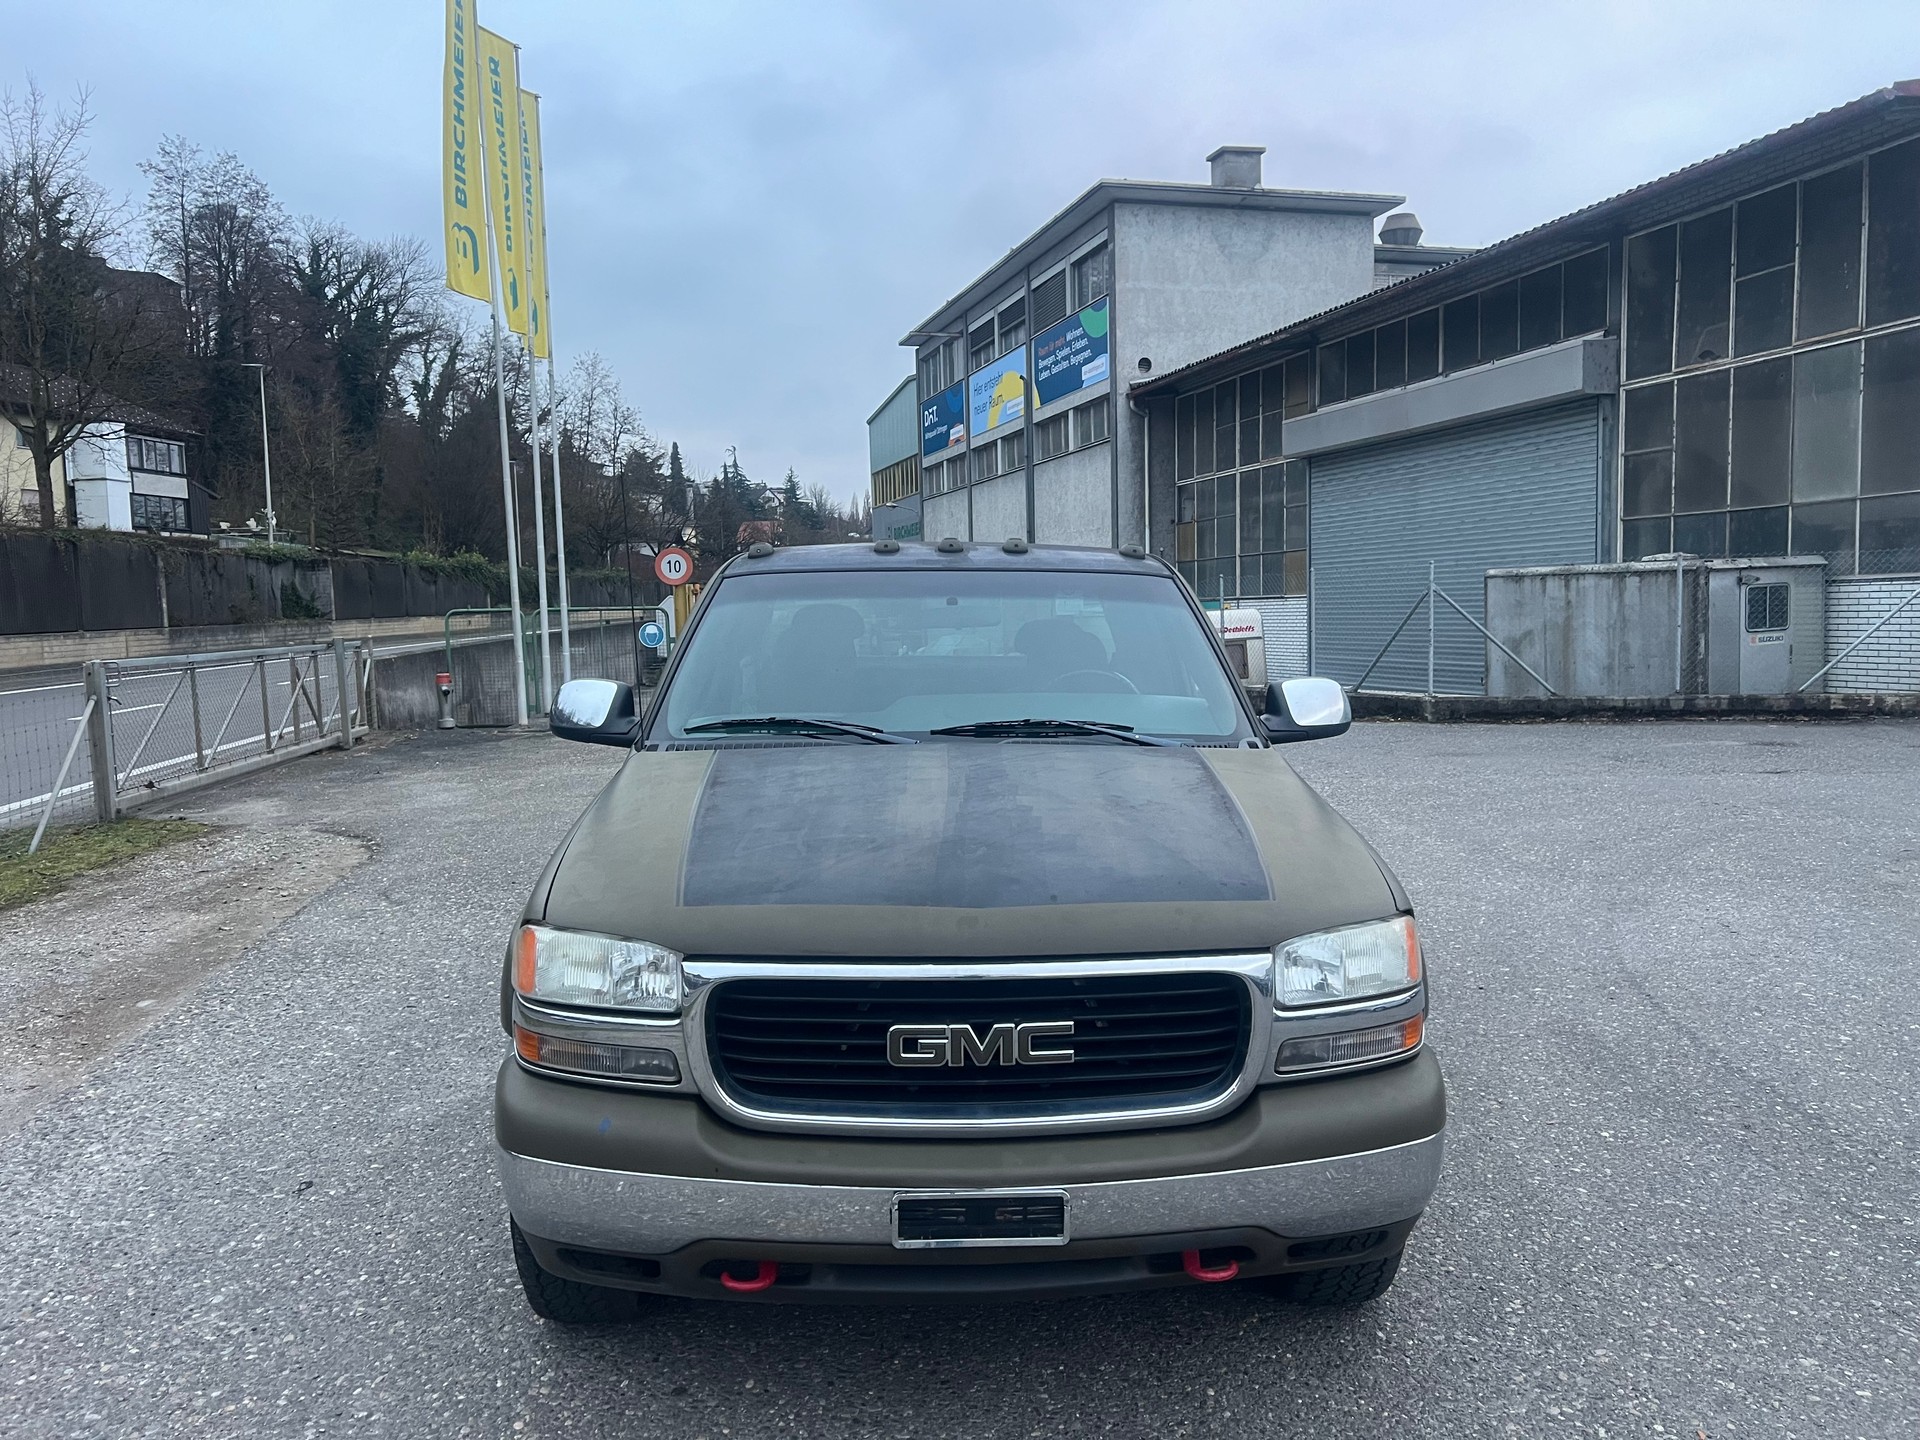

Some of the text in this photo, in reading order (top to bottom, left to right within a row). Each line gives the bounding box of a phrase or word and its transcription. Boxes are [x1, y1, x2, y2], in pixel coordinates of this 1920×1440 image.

[1071, 337, 1089, 352] Erleben.
[973, 382, 984, 397] Hier
[666, 559, 682, 573] 10
[1758, 635, 1784, 643] SUZUKI
[887, 1021, 1075, 1067] GMC
